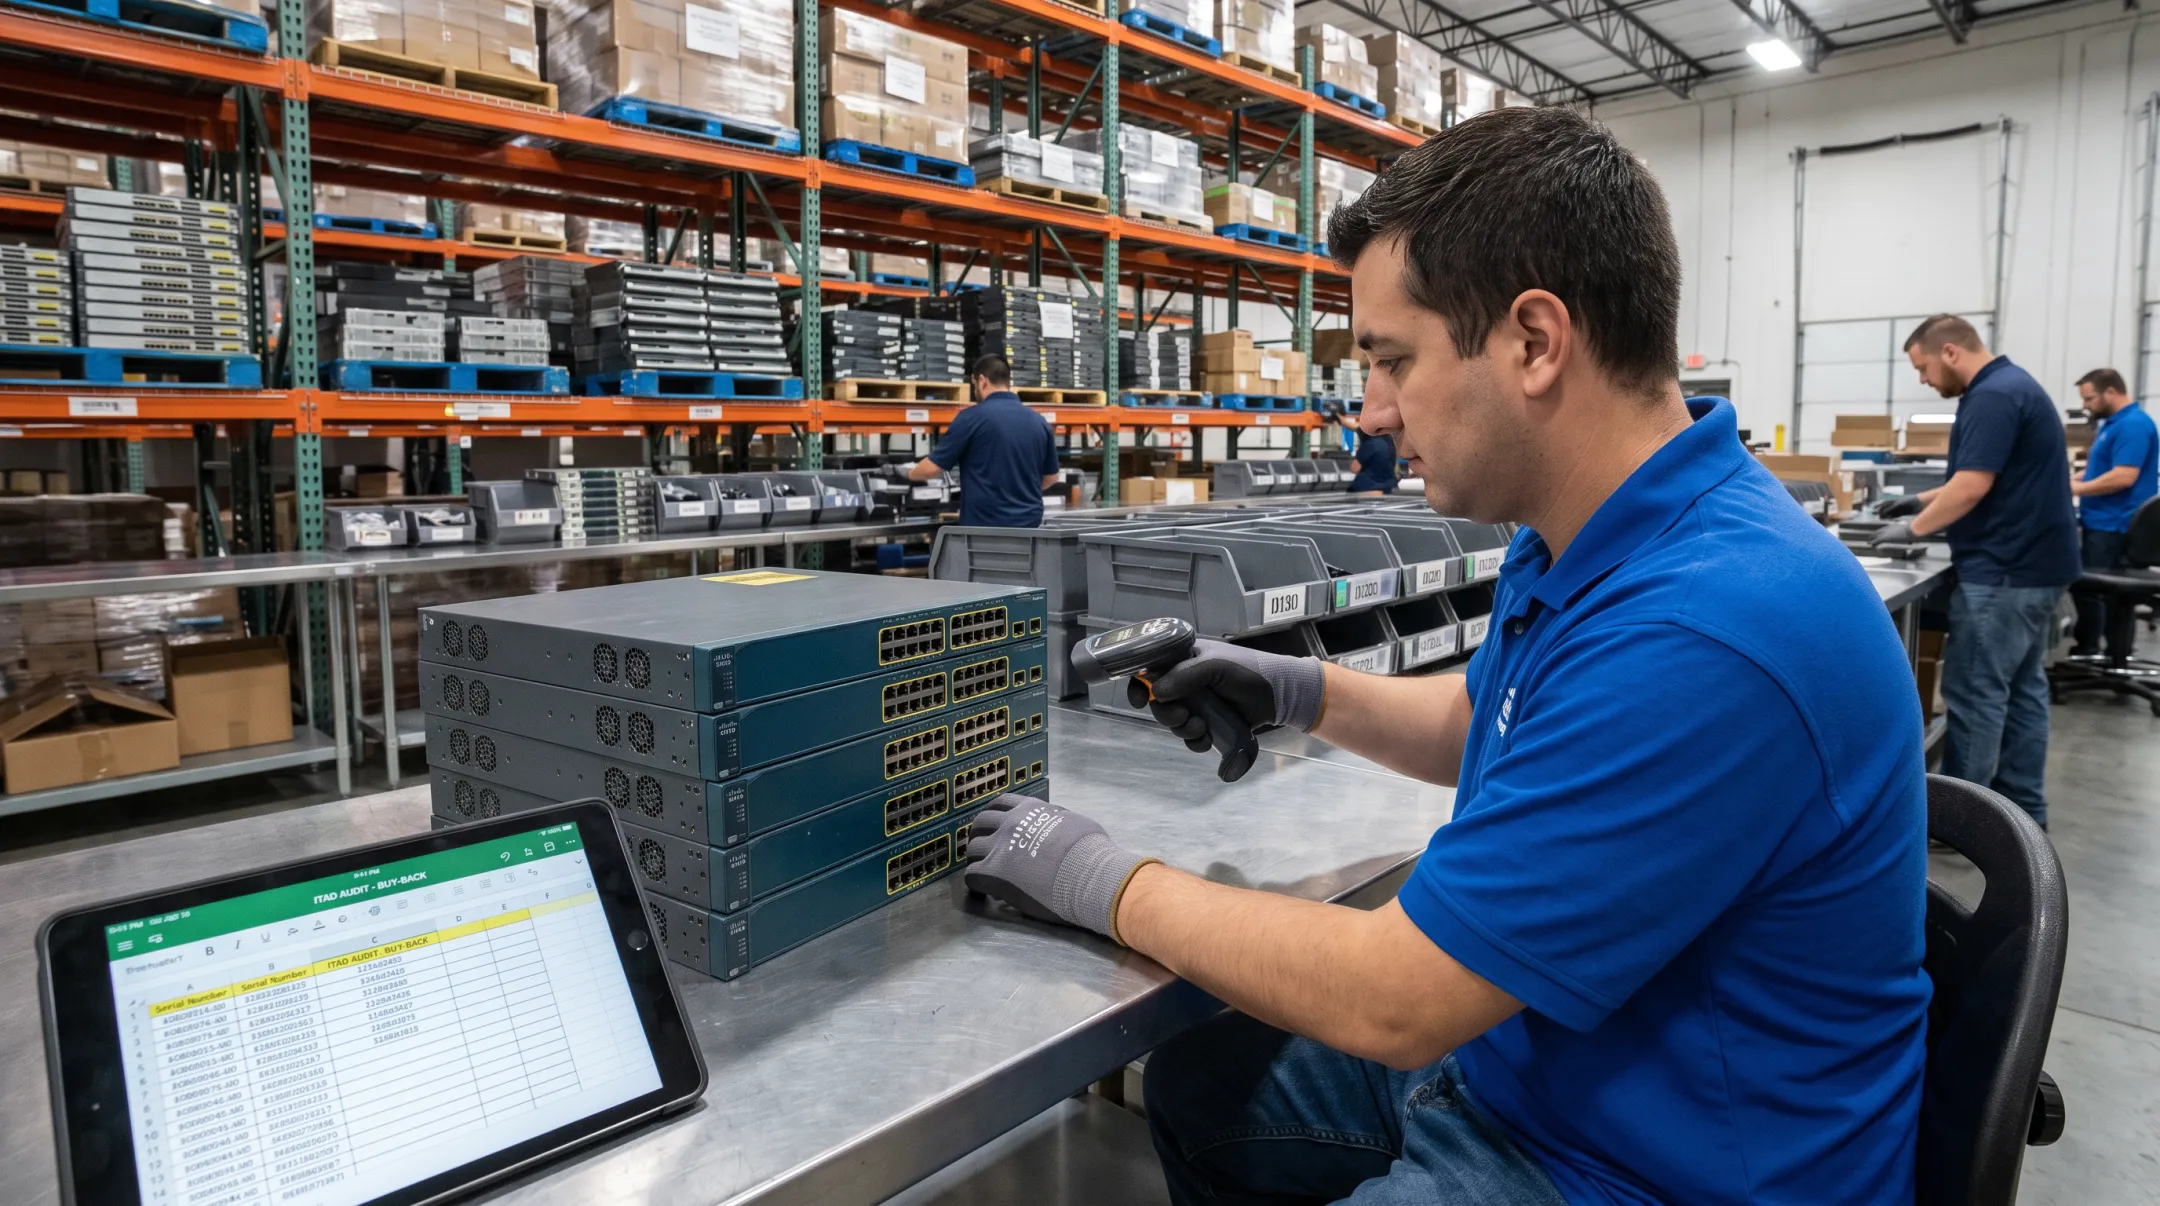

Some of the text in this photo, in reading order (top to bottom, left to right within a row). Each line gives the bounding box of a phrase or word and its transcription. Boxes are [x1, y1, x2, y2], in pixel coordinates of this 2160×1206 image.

[313, 891, 338, 905] ITAD
[339, 883, 370, 899] AUDIT
[377, 871, 428, 890] BUY-BACK
[371, 936, 379, 944] C
[351, 949, 379, 963] AUDIT
